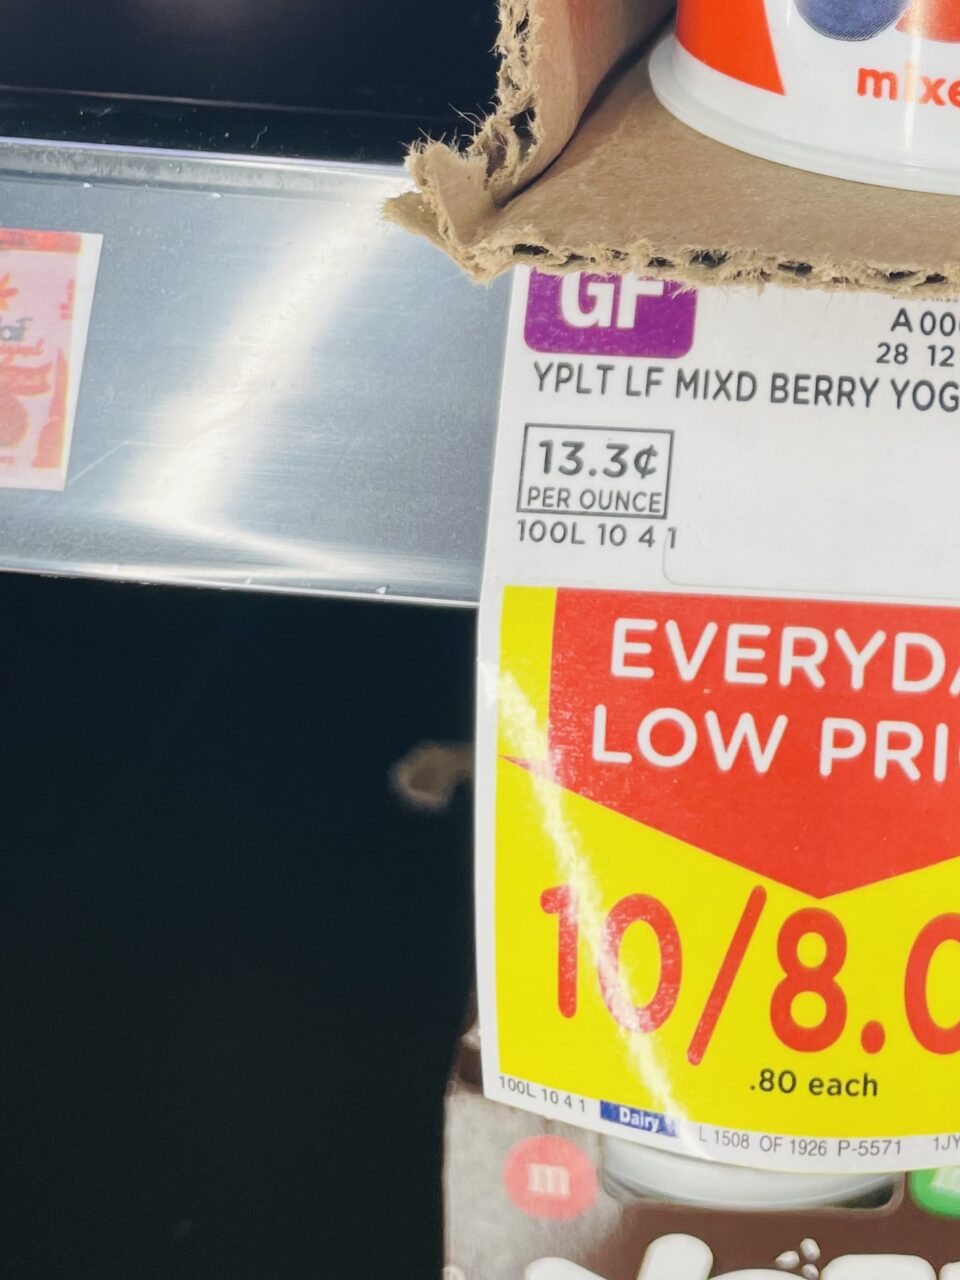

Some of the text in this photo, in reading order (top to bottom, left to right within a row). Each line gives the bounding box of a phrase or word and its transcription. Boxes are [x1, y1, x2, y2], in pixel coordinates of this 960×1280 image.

[876, 342, 909, 365] 28
[927, 344, 955, 367] 12
[533, 360, 615, 395] YPLT
[625, 365, 664, 398] LF
[675, 367, 758, 402] MIXD
[769, 372, 880, 409] BERRY
[538, 439, 659, 480] 13.3¢
[527, 486, 662, 513] PER OUNCE
[517, 519, 677, 549] 100L 10 4 1
[591, 704, 787, 774] LOW
[499, 1076, 586, 1113] 100L 10 4 1
[749, 1069, 878, 1099] .80 each
[619, 1106, 660, 1133] Dairy
[714, 1130, 750, 1150] 1508
[759, 1136, 783, 1154] OF
[789, 1139, 827, 1157] 1926
[837, 1140, 902, 1157] P-5571
